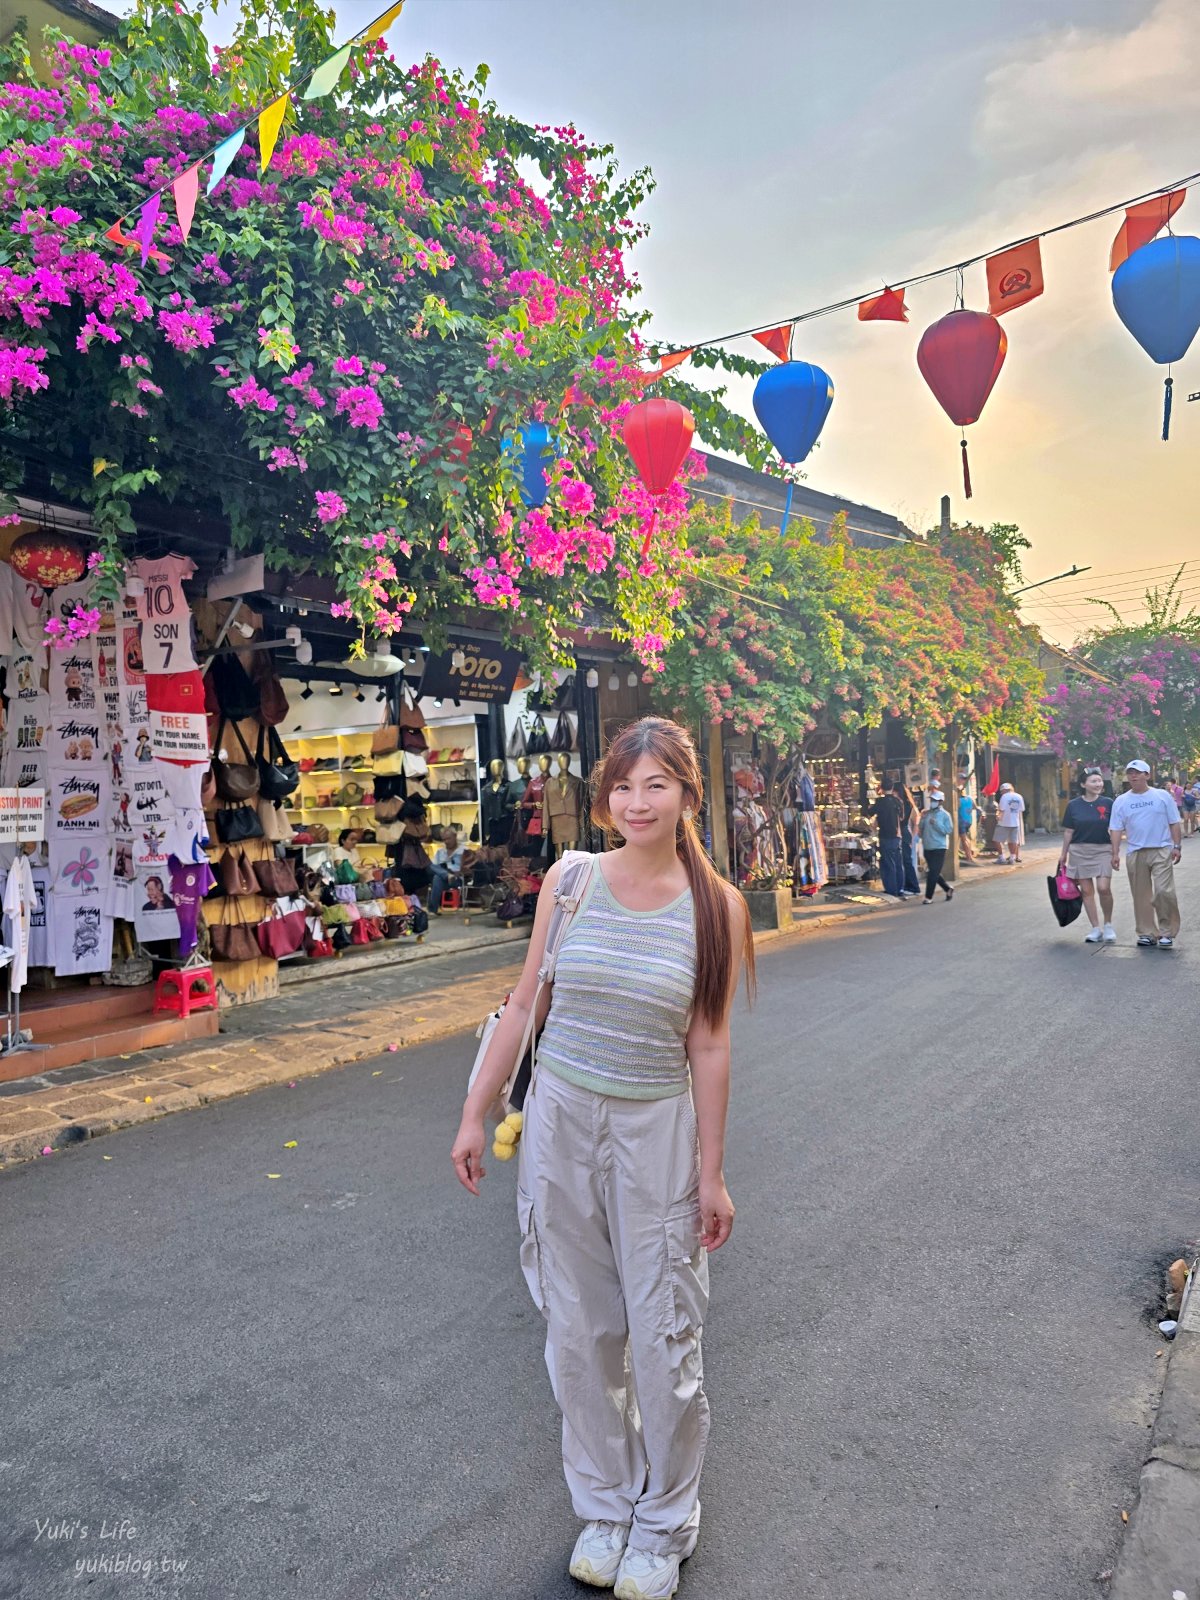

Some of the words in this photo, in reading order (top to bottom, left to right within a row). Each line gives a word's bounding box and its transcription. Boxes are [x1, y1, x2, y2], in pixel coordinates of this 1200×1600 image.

[144, 585, 174, 618] 10
[154, 624, 178, 639] SON
[160, 642, 173, 668] 7
[448, 656, 502, 680] OTO
[161, 716, 189, 728] FREE
[166, 731, 180, 739] YOUR
[182, 732, 200, 741] NAME
[22, 797, 43, 809] PRINT
